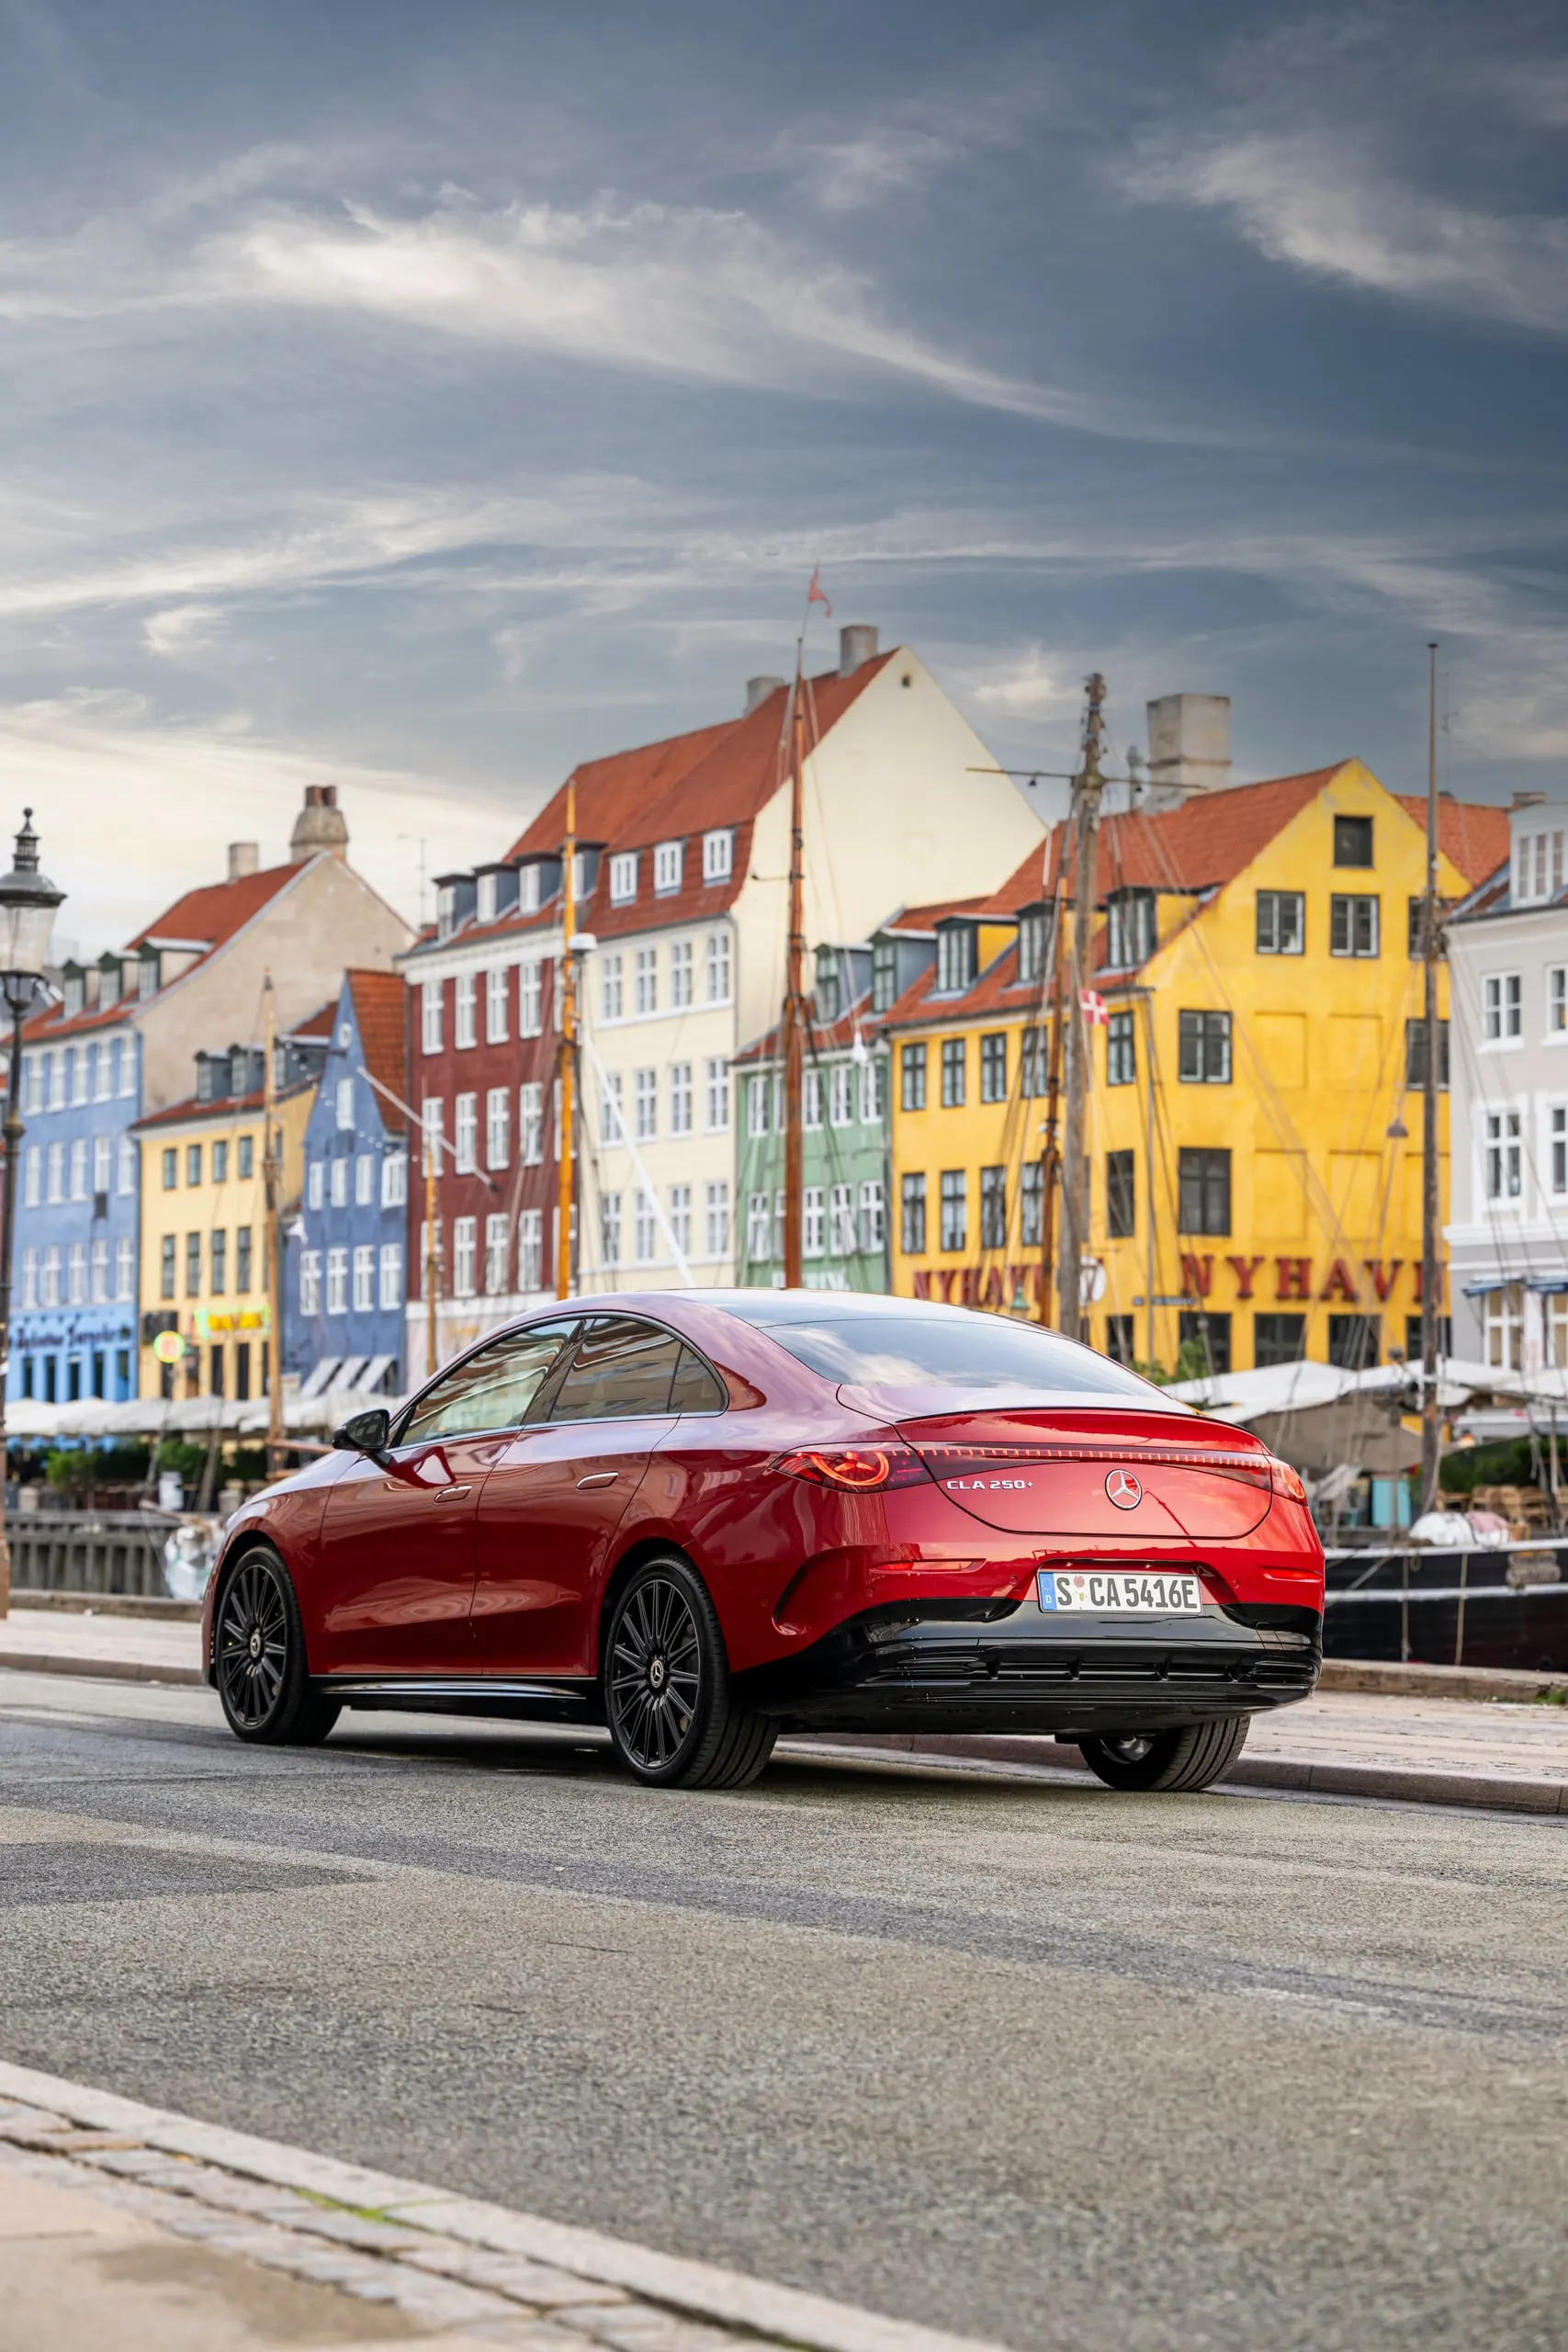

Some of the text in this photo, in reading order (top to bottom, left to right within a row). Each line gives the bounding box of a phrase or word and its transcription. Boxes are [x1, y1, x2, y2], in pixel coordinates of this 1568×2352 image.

[946, 1479, 1033, 1489] CLA 250+
[1056, 1577, 1072, 1606] S
